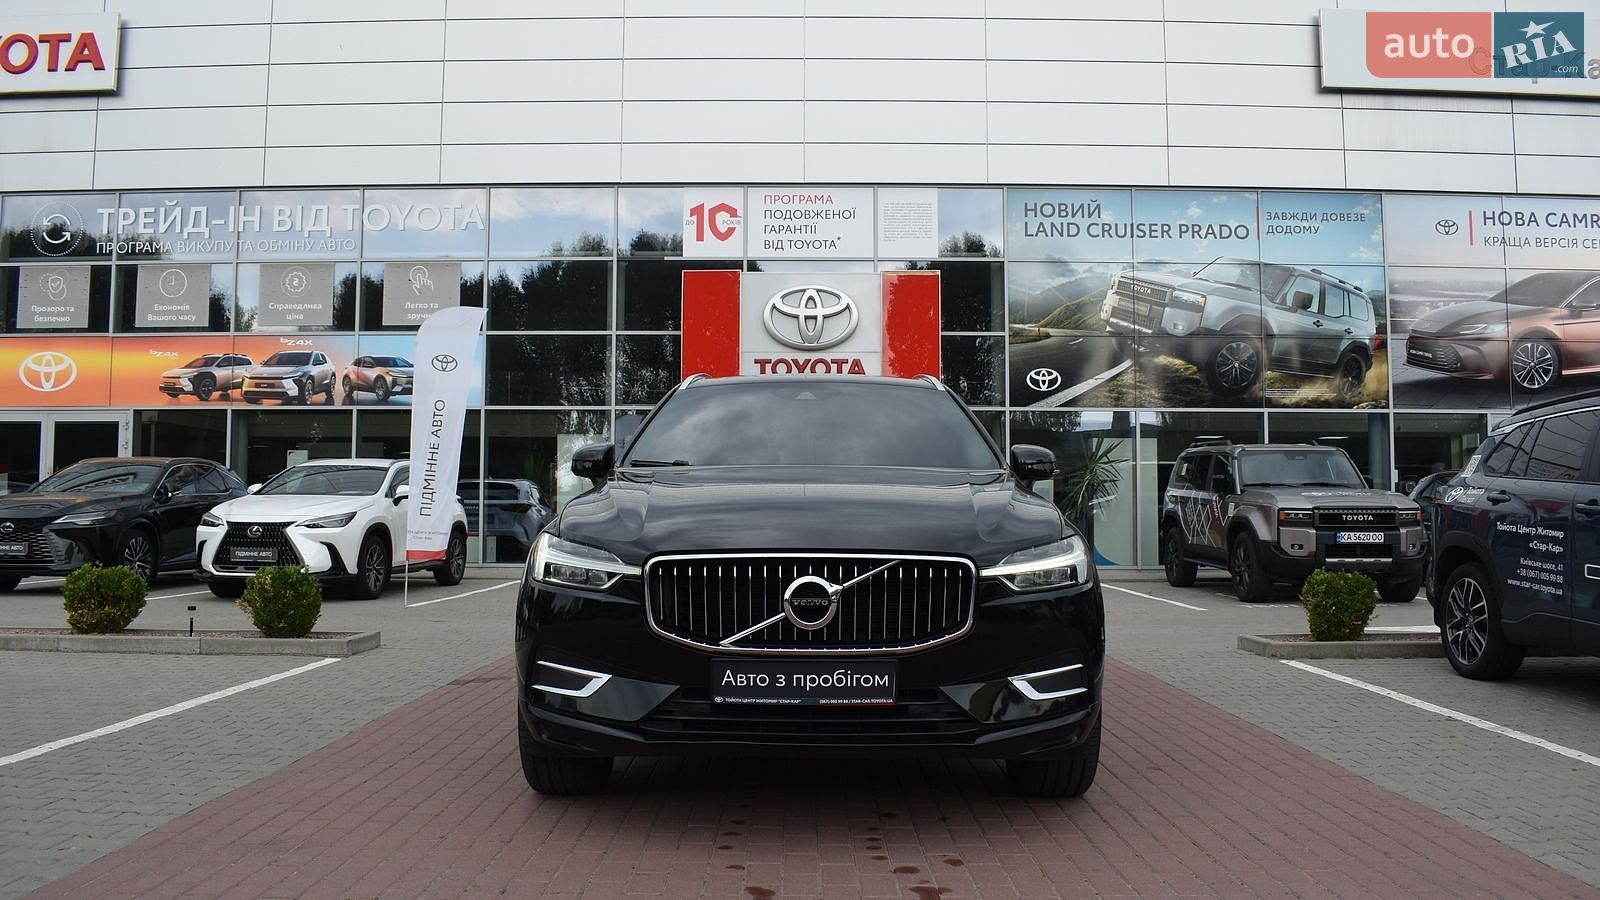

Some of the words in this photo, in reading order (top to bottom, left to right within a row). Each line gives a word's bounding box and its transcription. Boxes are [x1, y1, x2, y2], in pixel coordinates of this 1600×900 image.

[0, 32, 105, 74] OTA
[764, 194, 834, 205] ПРОГРАМА
[764, 207, 857, 221] ПОДОВЖЕНОЇ
[1024, 199, 1102, 219] НОВИЙ
[1266, 211, 1318, 222] ЗАВЖДИ
[1320, 212, 1367, 223] ДОВЕЗЕ
[97, 199, 261, 239] ТРЕЙД-ІН
[272, 204, 332, 238] ВІД
[343, 203, 486, 232] TOYOTA
[1482, 210, 1540, 228] НОВА
[764, 222, 818, 235] ГАРАНТІЇ
[1024, 221, 1081, 238] LAND
[1086, 222, 1172, 239] CRUISER
[1178, 223, 1250, 240] PRADO
[1266, 225, 1321, 236] ДОДОМУ
[96, 242, 173, 254] ПРОГРАМА
[177, 240, 234, 253] ВИКУПУ
[237, 240, 254, 252] ТА
[256, 239, 318, 252] ОБМІНУ
[319, 238, 356, 251] АВТО
[764, 240, 785, 251] ВІД
[1483, 236, 1531, 249] КРАЩА
[1535, 237, 1578, 249] ВЕРСІЯ
[1582, 238, 1600, 249] СЕ
[268, 301, 323, 311] Справедлива
[754, 357, 866, 375] TOYOTA
[419, 442, 440, 517] ПІДМІННЕ
[430, 399, 446, 439] АВТО
[1340, 533, 1352, 542] KA
[1353, 532, 1370, 542] 5620
[1496, 521, 1517, 533] Тойота
[1517, 524, 1537, 536] Центр
[1537, 526, 1565, 540] Житомир
[721, 669, 769, 688] Авто
[775, 674, 787, 687] з
[793, 669, 890, 691] пробігом
